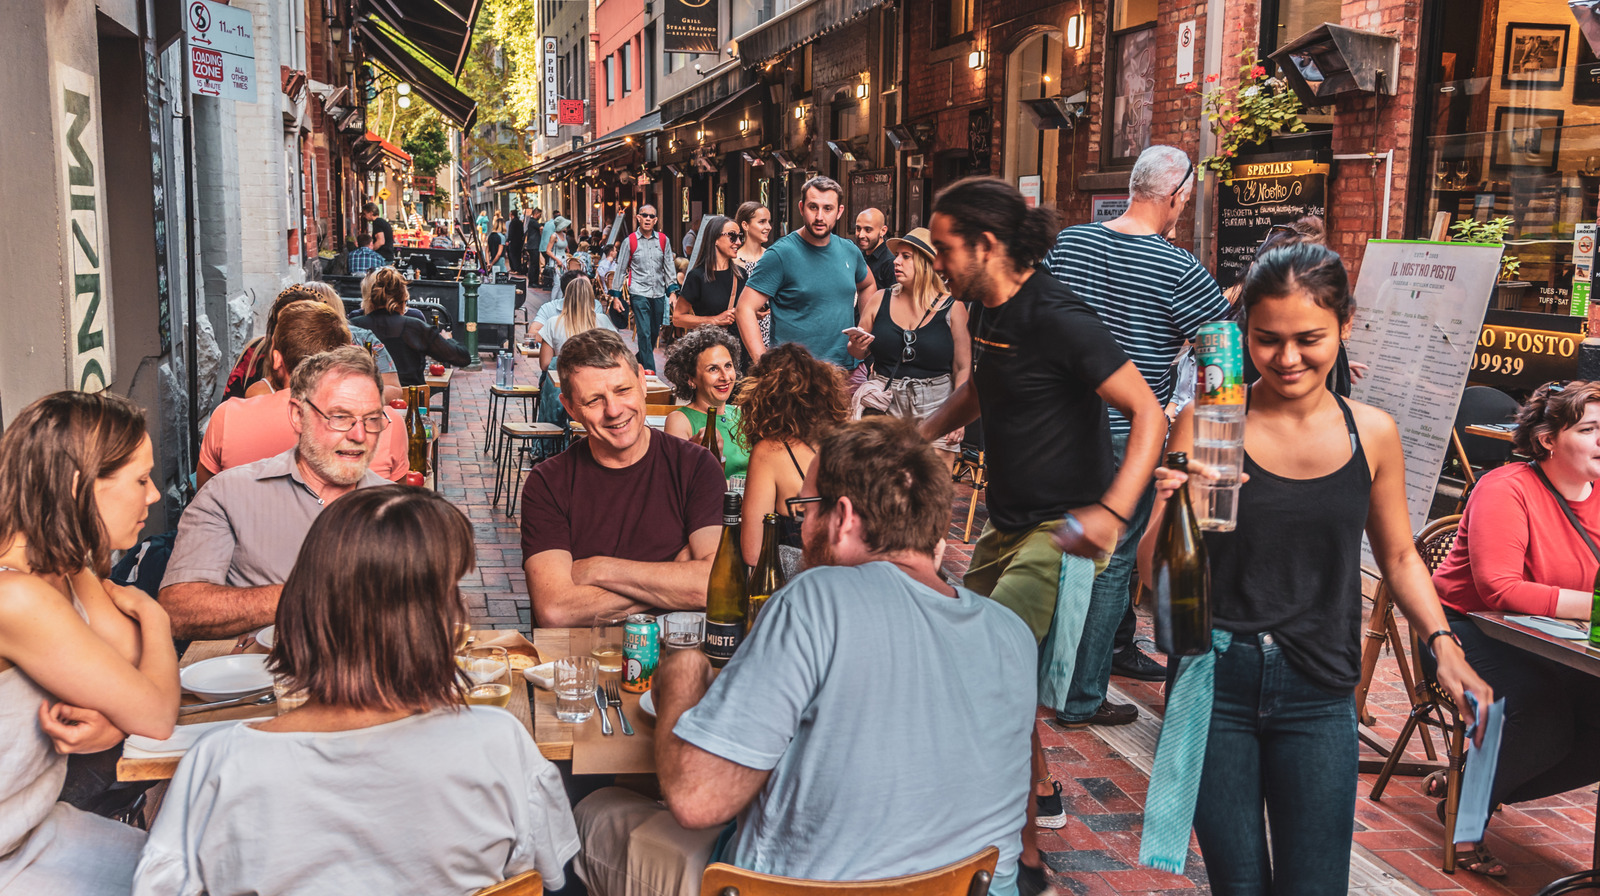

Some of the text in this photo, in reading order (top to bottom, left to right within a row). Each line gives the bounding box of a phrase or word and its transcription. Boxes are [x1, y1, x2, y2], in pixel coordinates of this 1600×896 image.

[192, 50, 222, 66] LOADING
[194, 64, 221, 78] ZONE
[231, 74, 248, 82] OTHER
[233, 82, 248, 90] TIMES
[1248, 162, 1292, 176] SPECIALS
[1390, 262, 1456, 282] IL NOSTRO POSTO
[1477, 328, 1496, 347] O
[1503, 331, 1575, 358] POSTO
[706, 633, 735, 647] MUSTE
